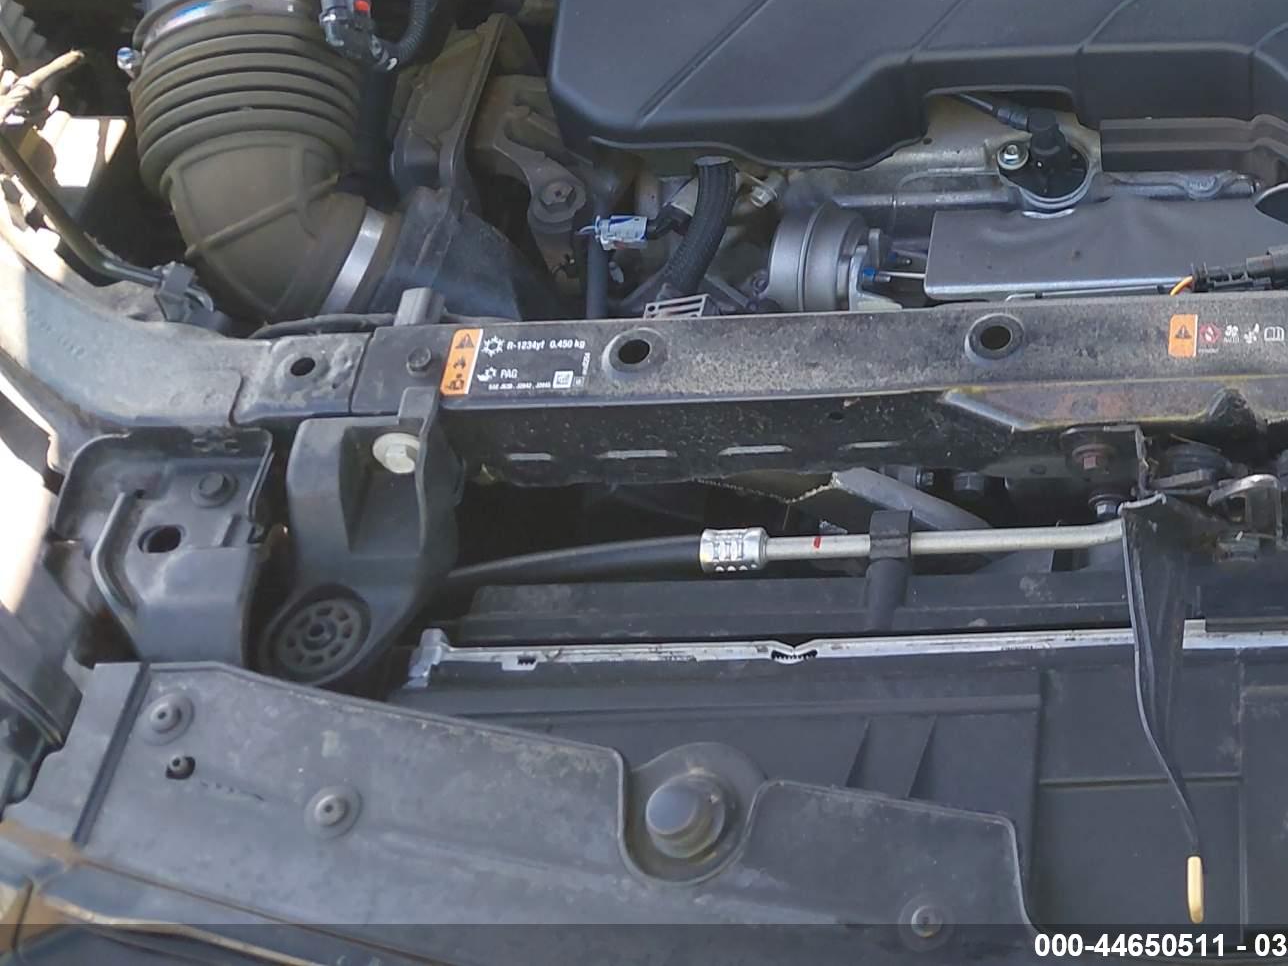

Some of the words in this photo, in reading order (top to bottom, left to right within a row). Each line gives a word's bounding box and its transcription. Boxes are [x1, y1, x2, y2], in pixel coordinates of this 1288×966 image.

[507, 340, 545, 351] R-1234yf
[549, 339, 573, 349] 0.450
[574, 339, 586, 349] kg
[500, 369, 518, 379] PAG
